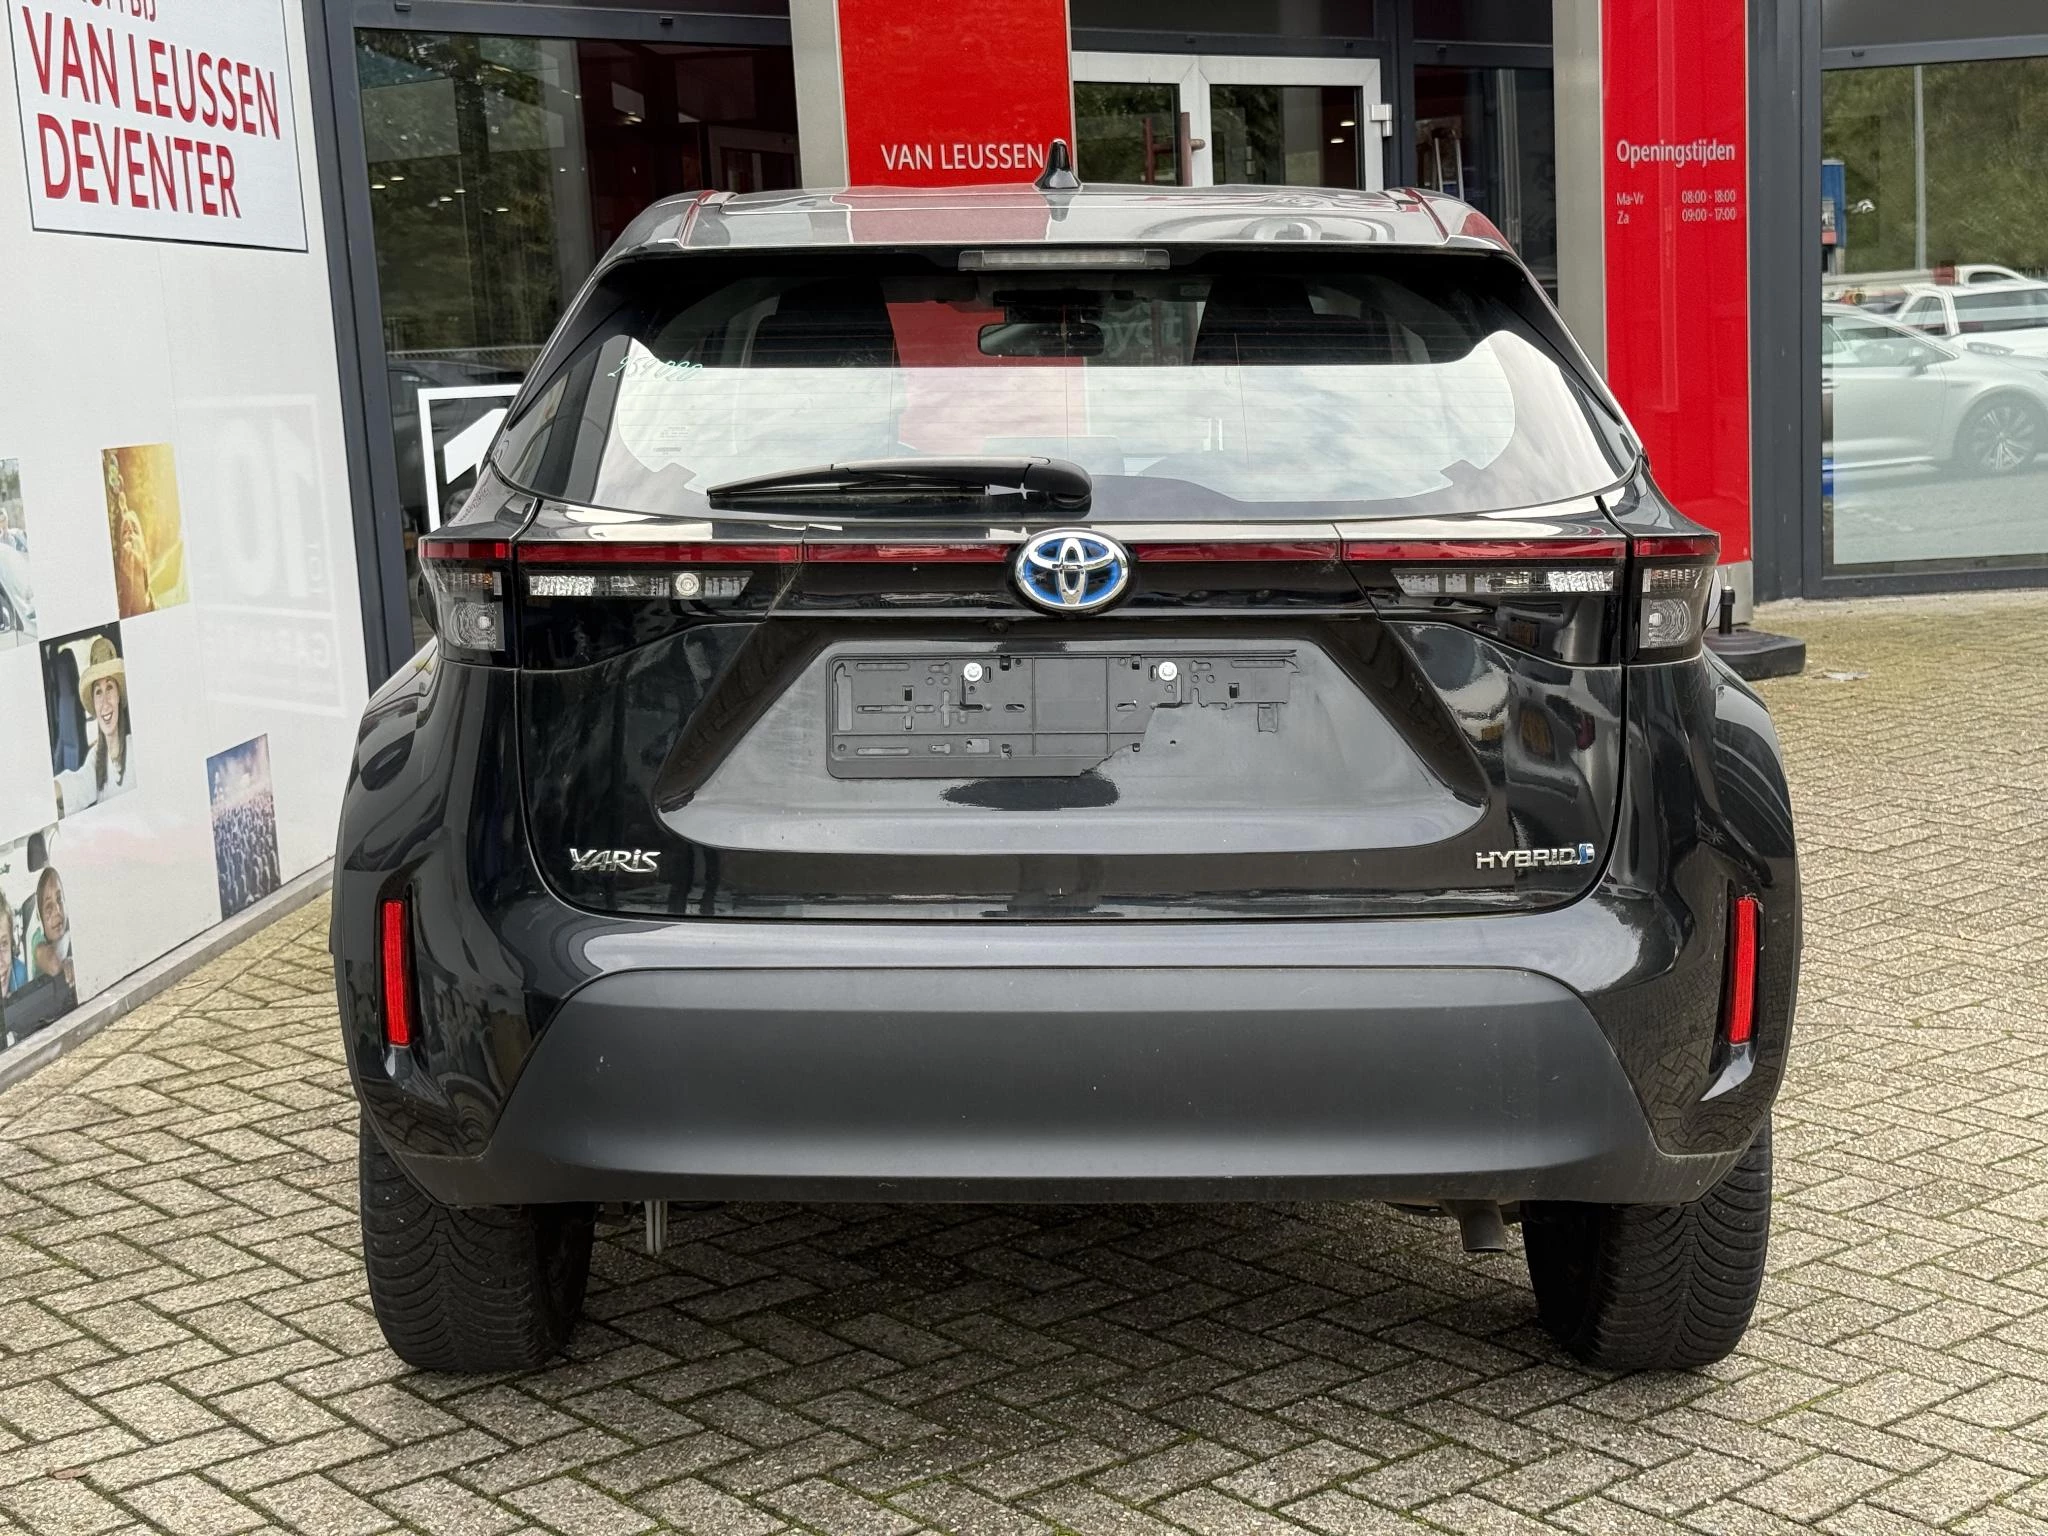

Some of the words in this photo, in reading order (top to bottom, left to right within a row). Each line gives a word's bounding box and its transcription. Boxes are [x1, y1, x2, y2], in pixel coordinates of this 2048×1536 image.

[22, 6, 121, 109] VAN
[128, 33, 281, 140] LEUSSEN
[37, 113, 242, 218] DEVENTER
[880, 144, 933, 170] VAN
[940, 143, 1044, 170] LEUSSEN
[1616, 139, 1736, 168] Openingstijden
[1616, 192, 1644, 206] Ma-Vr
[1681, 190, 1707, 204] 08:00
[1714, 190, 1736, 204] 18:00
[1616, 210, 1630, 224] Za
[1681, 208, 1707, 222] 09:00
[1714, 207, 1736, 221] 17:00
[1475, 847, 1577, 870] HYBRID
